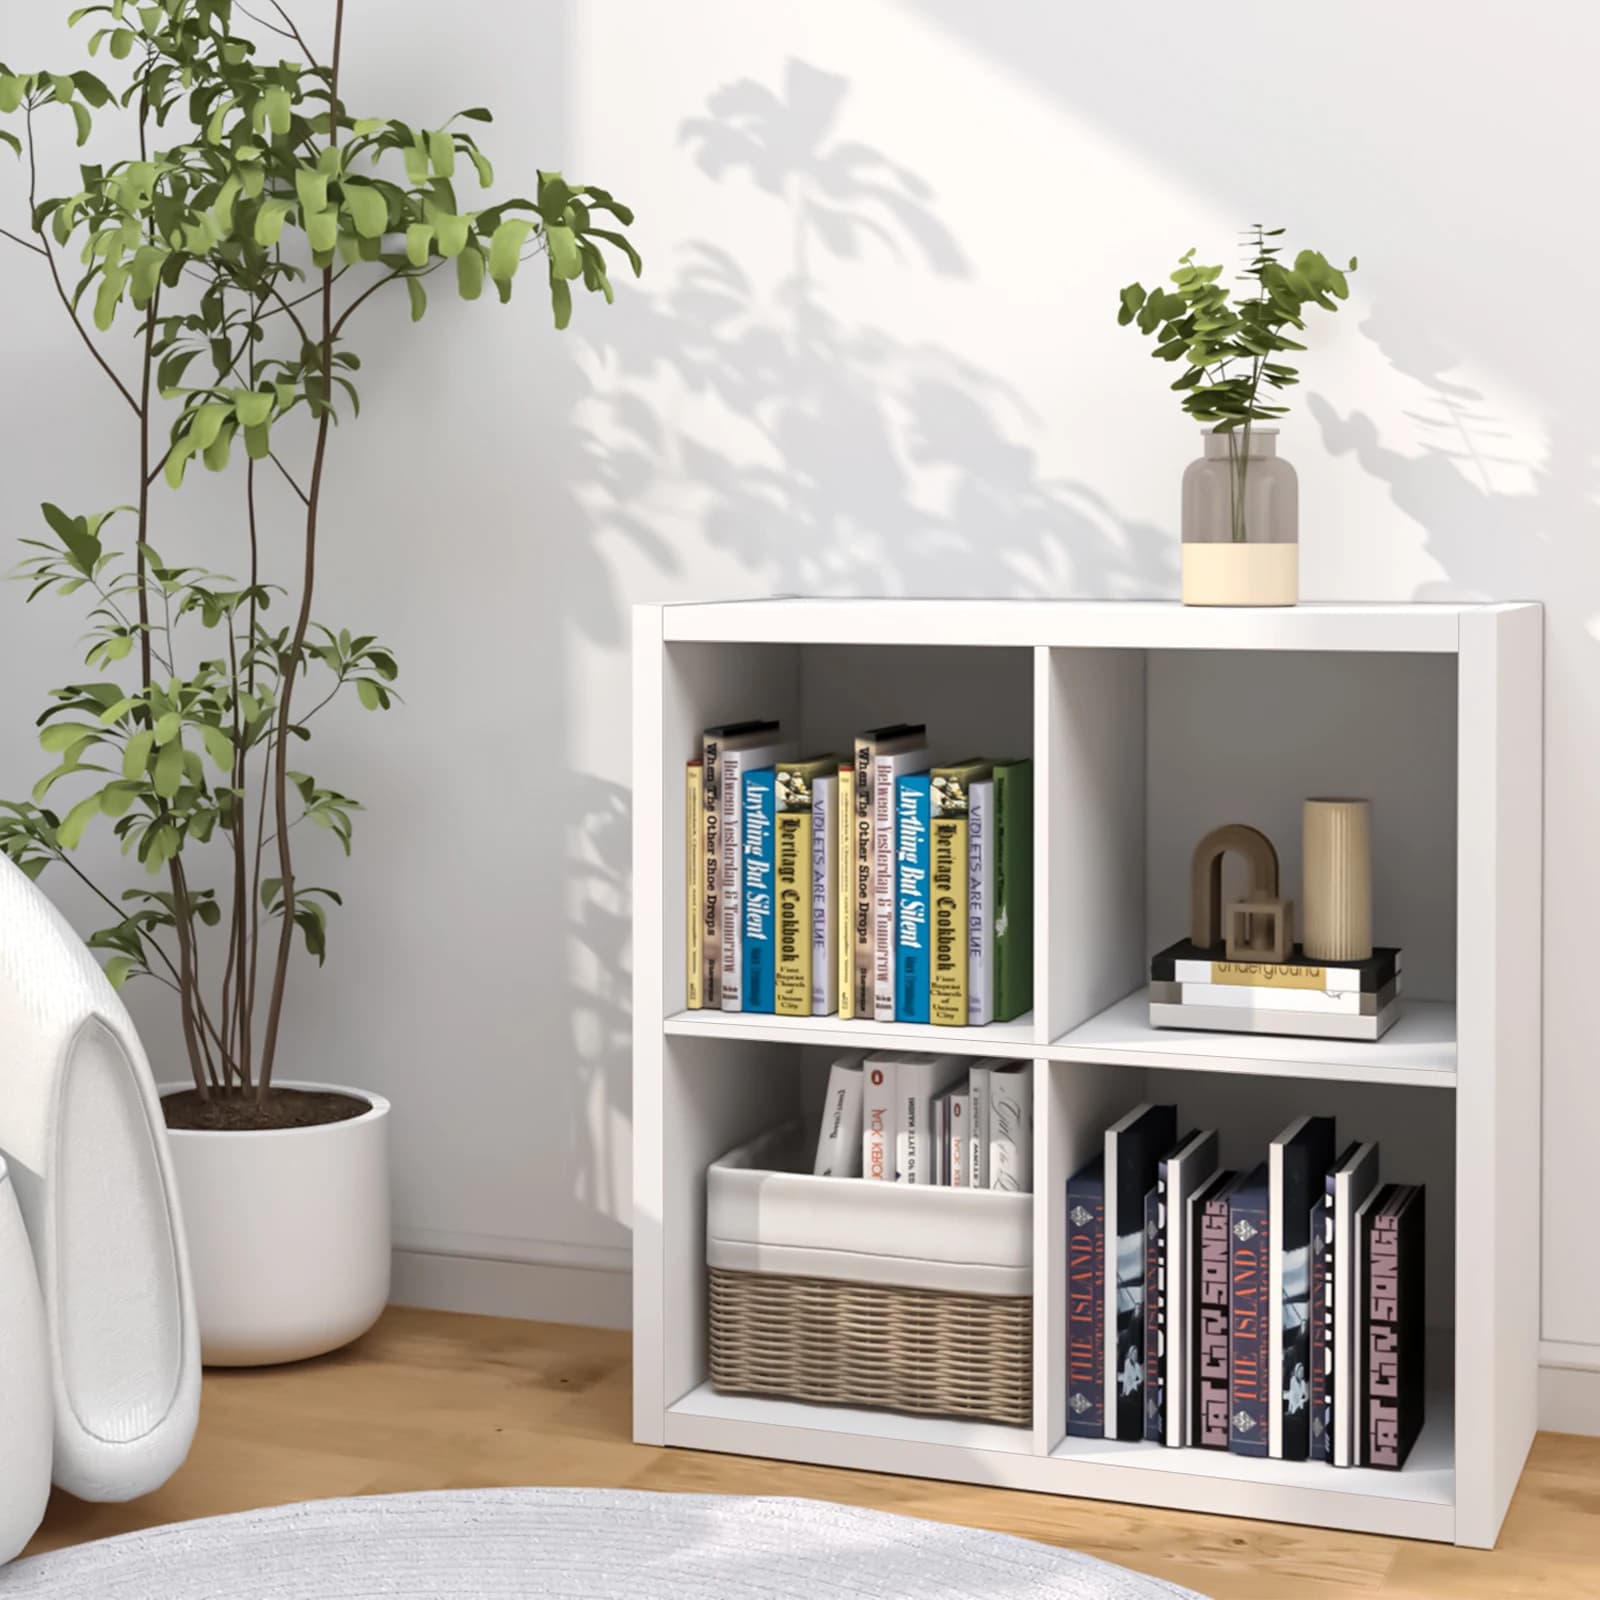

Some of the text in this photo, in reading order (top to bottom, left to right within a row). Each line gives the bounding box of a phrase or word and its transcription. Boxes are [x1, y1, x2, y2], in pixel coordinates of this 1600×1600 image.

[723, 760, 738, 815] Between
[743, 781, 770, 855] Anything
[877, 764, 892, 821] Between
[704, 743, 717, 935] When The Other Shoe Drops
[721, 820, 739, 887] Yesterday
[856, 747, 870, 944] When The Other Shoe Drops
[874, 826, 892, 894] Yesterday
[896, 786, 926, 862] Anything
[747, 859, 769, 888] But
[779, 818, 800, 962] Heritage Cookbook
[813, 800, 826, 949] VIOLETS ARE BLUE
[900, 866, 924, 896] But
[935, 824, 957, 971] Heritage Cookbook
[970, 805, 982, 958] VIOLETS ARE BLUE
[723, 905, 738, 974] Tomorrow
[746, 891, 770, 940] Silent
[877, 912, 892, 982] Tomorrow
[900, 898, 925, 949] Silent
[1201, 1201, 1229, 1304] SONGS
[1370, 1216, 1398, 1322] SONGS
[1070, 1235, 1093, 1385] THE ISLAND
[1235, 1248, 1257, 1403] THE ISLAND
[1201, 1381, 1229, 1446] FAT
[1370, 1398, 1398, 1465] FAT
